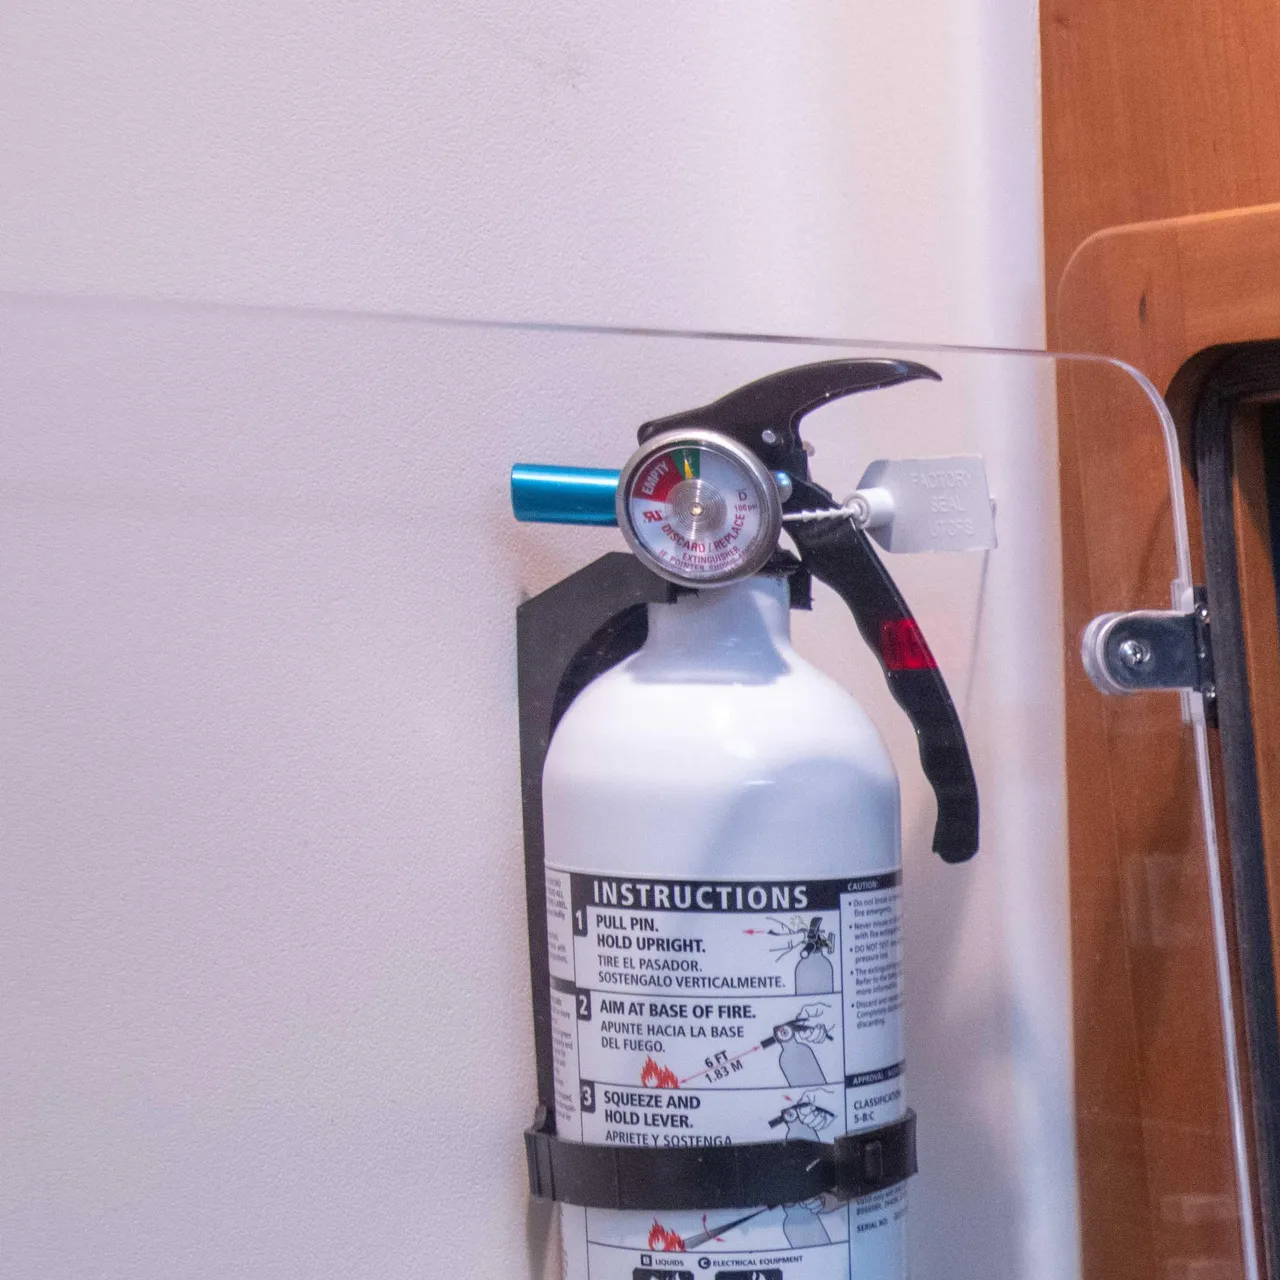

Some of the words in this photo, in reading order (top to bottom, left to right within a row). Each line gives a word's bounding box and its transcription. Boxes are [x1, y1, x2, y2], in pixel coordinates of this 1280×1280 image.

[642, 461, 669, 495] EMPTY
[930, 496, 966, 512] SEAL
[662, 523, 705, 553] DISCARD
[714, 514, 745, 550] REPLACE
[682, 546, 739, 564] EXTINGUISHER
[593, 880, 808, 909] INSTRUCTIONS
[596, 914, 626, 930] PULL
[630, 917, 659, 932] PIN.
[597, 933, 632, 950] HOLD
[636, 937, 706, 953] UPRIGHT.
[598, 954, 619, 968] TIRE
[623, 956, 635, 969] EL
[639, 958, 702, 972] PASADOR.
[598, 971, 672, 987] SOSTENGALO
[676, 975, 786, 989] VERTICALMENTE.
[600, 999, 624, 1015] AIM
[628, 1002, 645, 1017] AT
[650, 1004, 688, 1018] BASE
[692, 1005, 714, 1019] OF
[718, 1005, 756, 1019] FIRE.
[601, 1021, 643, 1036] APUNTE
[647, 1024, 686, 1037] HACIA
[690, 1026, 706, 1038] LA
[711, 1026, 744, 1038] BASE
[604, 1091, 662, 1108] SQUEEZE
[666, 1096, 701, 1109] AND
[605, 1109, 640, 1125] HOLD
[644, 1114, 694, 1128] LEVER.
[655, 1259, 684, 1267] LIQUIDS
[713, 1257, 756, 1267] ELECTRICAL
[759, 1255, 803, 1265] EQUIPMENT
